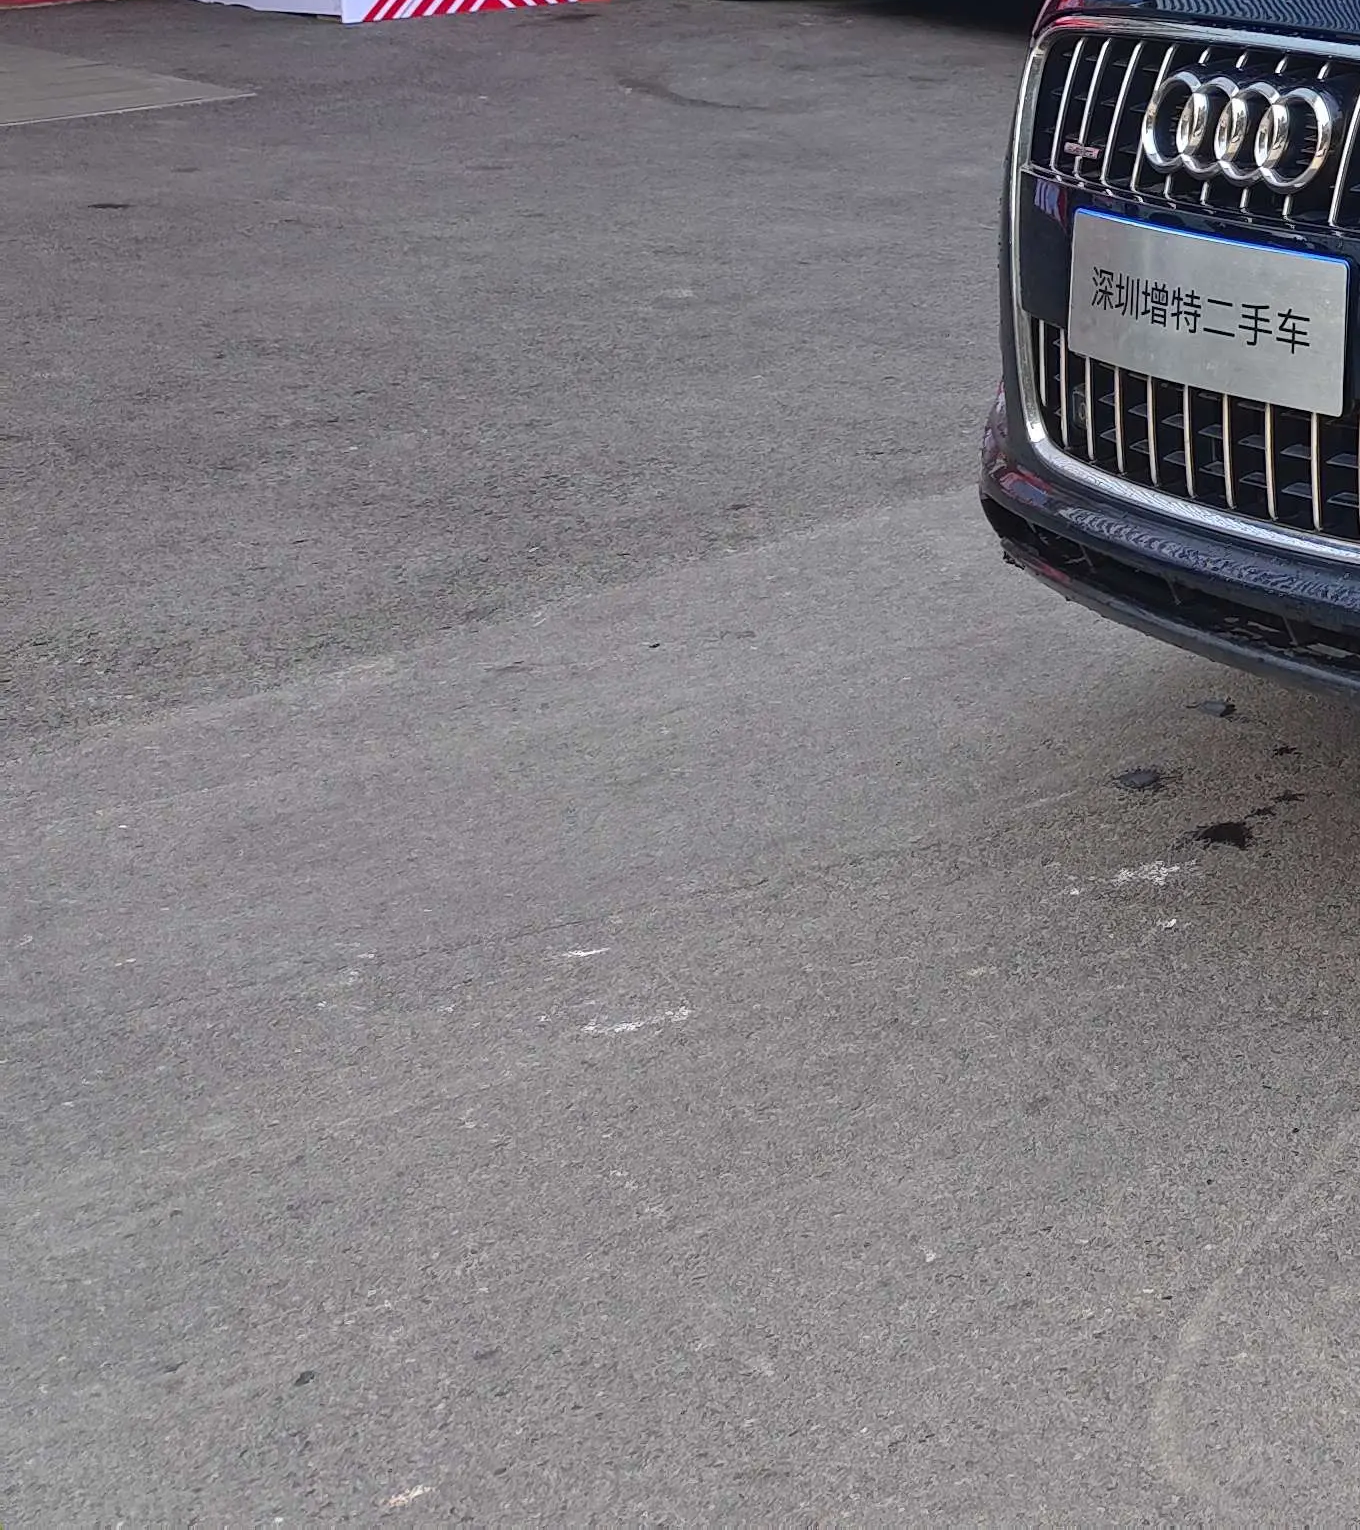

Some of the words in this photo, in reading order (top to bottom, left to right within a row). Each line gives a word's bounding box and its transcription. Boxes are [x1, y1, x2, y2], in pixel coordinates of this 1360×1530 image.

[1091, 266, 1310, 354] 深圳增特二手车
